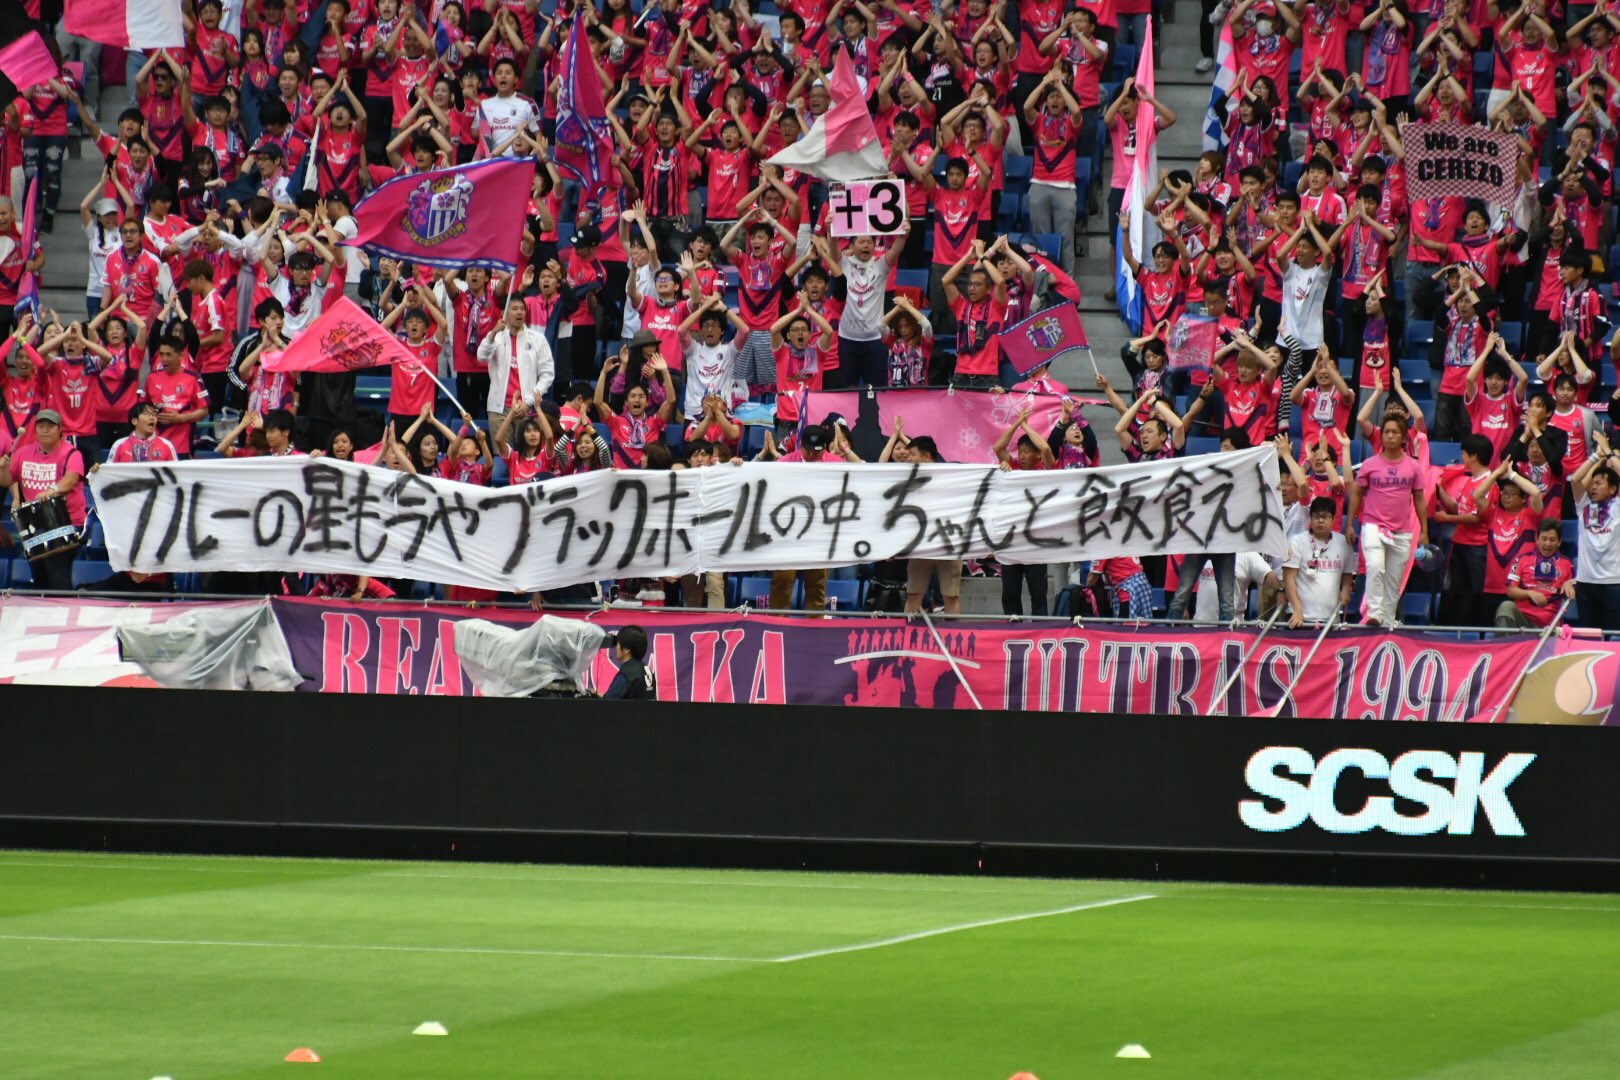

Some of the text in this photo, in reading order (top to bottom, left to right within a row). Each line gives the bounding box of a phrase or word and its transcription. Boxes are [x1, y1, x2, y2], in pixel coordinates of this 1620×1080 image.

[1424, 132, 1499, 157] We are
[1417, 158, 1504, 185] CEREZO
[891, 368, 902, 381] 10
[69, 394, 82, 408] 10
[22, 469, 57, 481] ULTRAS
[1332, 641, 1492, 722] 1994
[1238, 746, 1537, 836] SCSK
